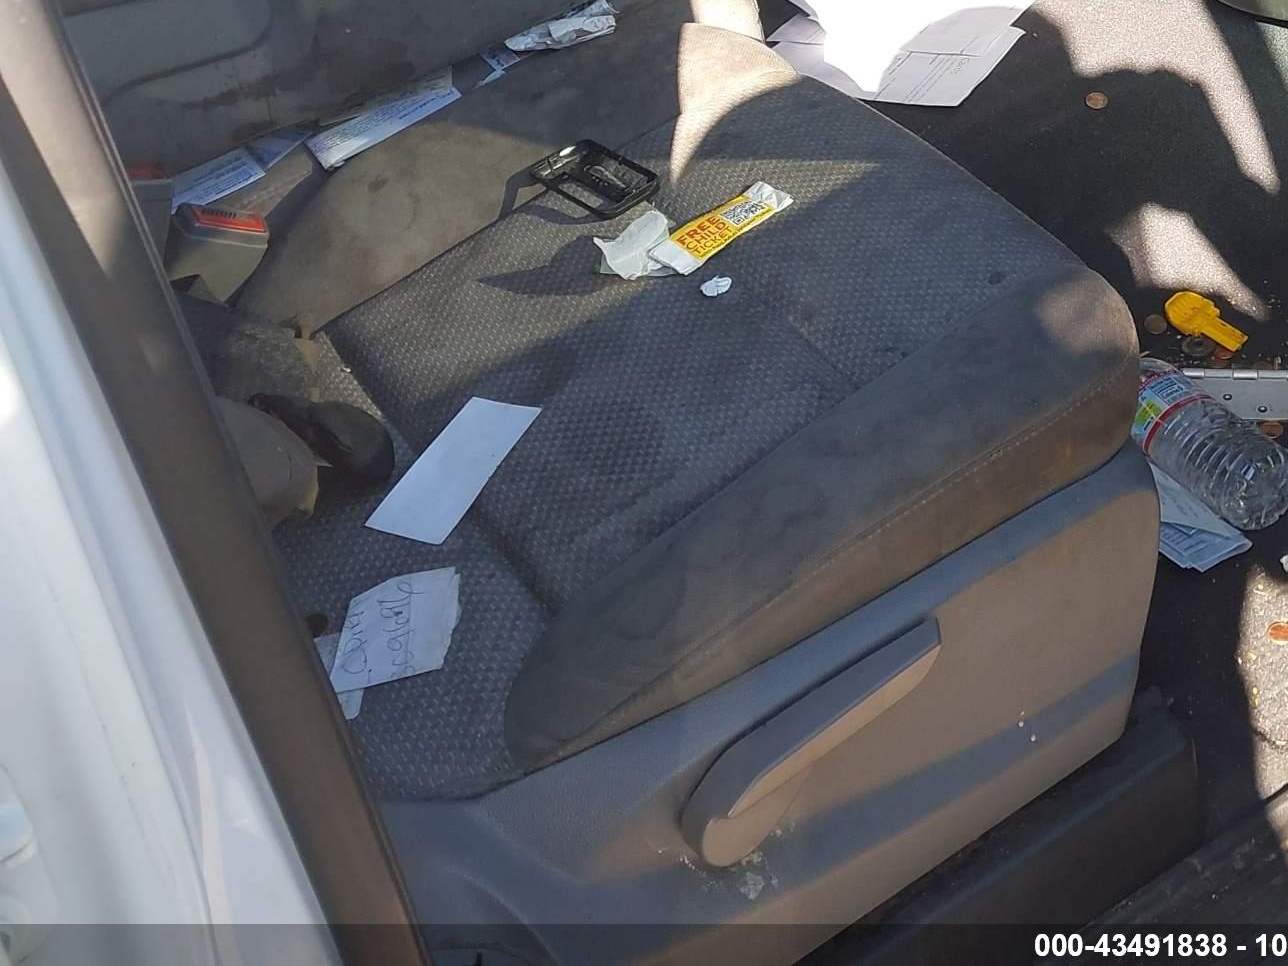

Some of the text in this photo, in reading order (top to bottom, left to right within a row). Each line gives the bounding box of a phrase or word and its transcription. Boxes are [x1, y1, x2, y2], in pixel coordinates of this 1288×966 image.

[676, 216, 721, 245] FREE
[686, 221, 727, 250] CHILD
[694, 225, 734, 254] TICKET
